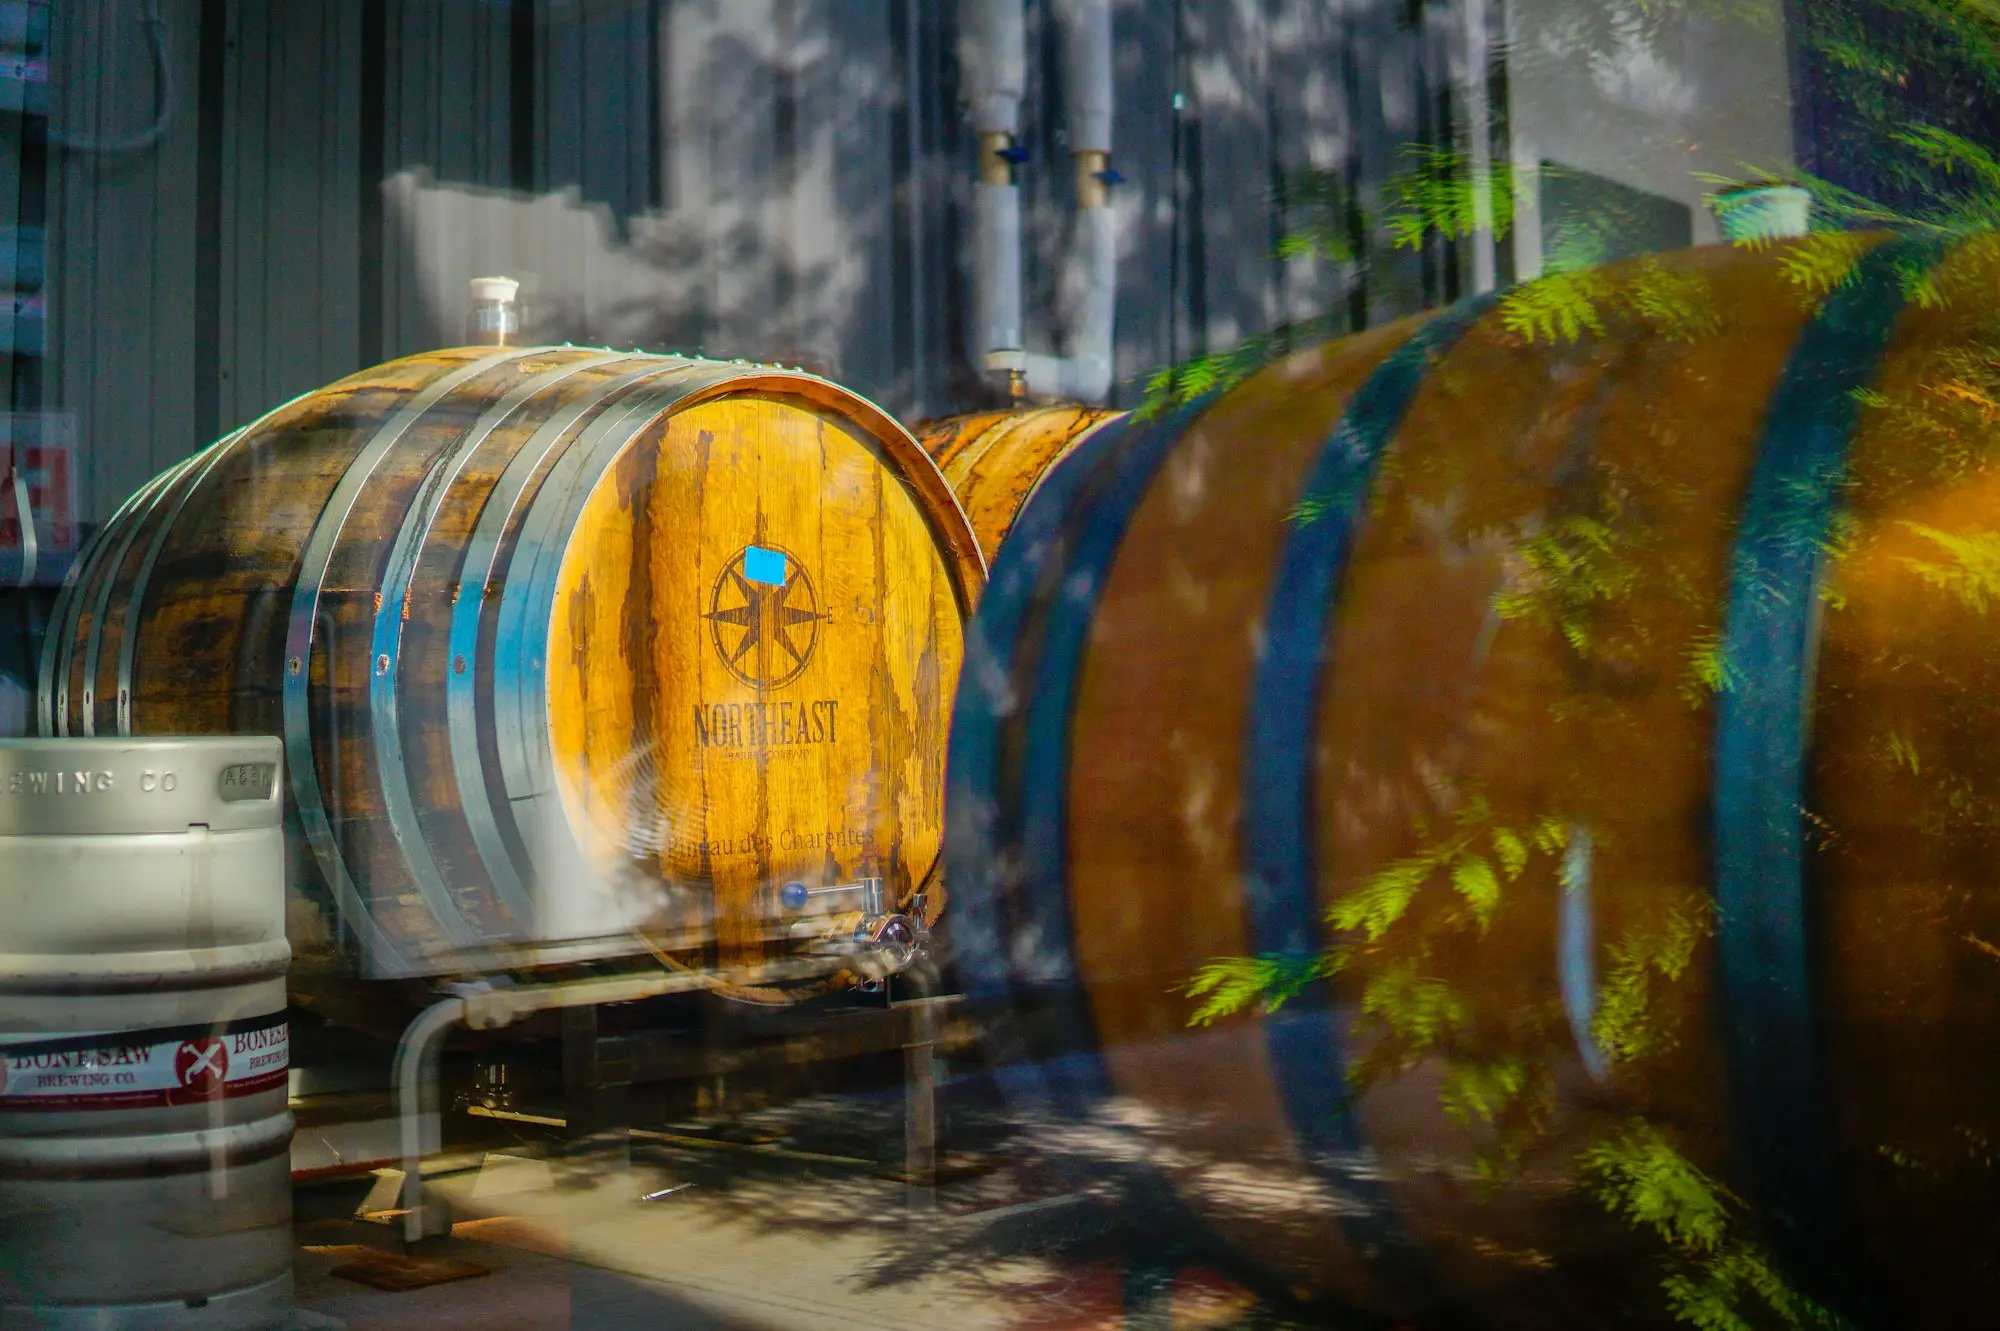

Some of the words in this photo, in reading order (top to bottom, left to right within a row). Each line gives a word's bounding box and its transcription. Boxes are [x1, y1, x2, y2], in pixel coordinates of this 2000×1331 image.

[827, 606, 833, 624] E
[693, 701, 839, 748] NORTHEAST
[0, 769, 114, 794] EWING
[140, 769, 177, 792] CO
[740, 829, 773, 853] des
[780, 827, 875, 851] Charentes
[37, 1072, 110, 1088] BREWING
